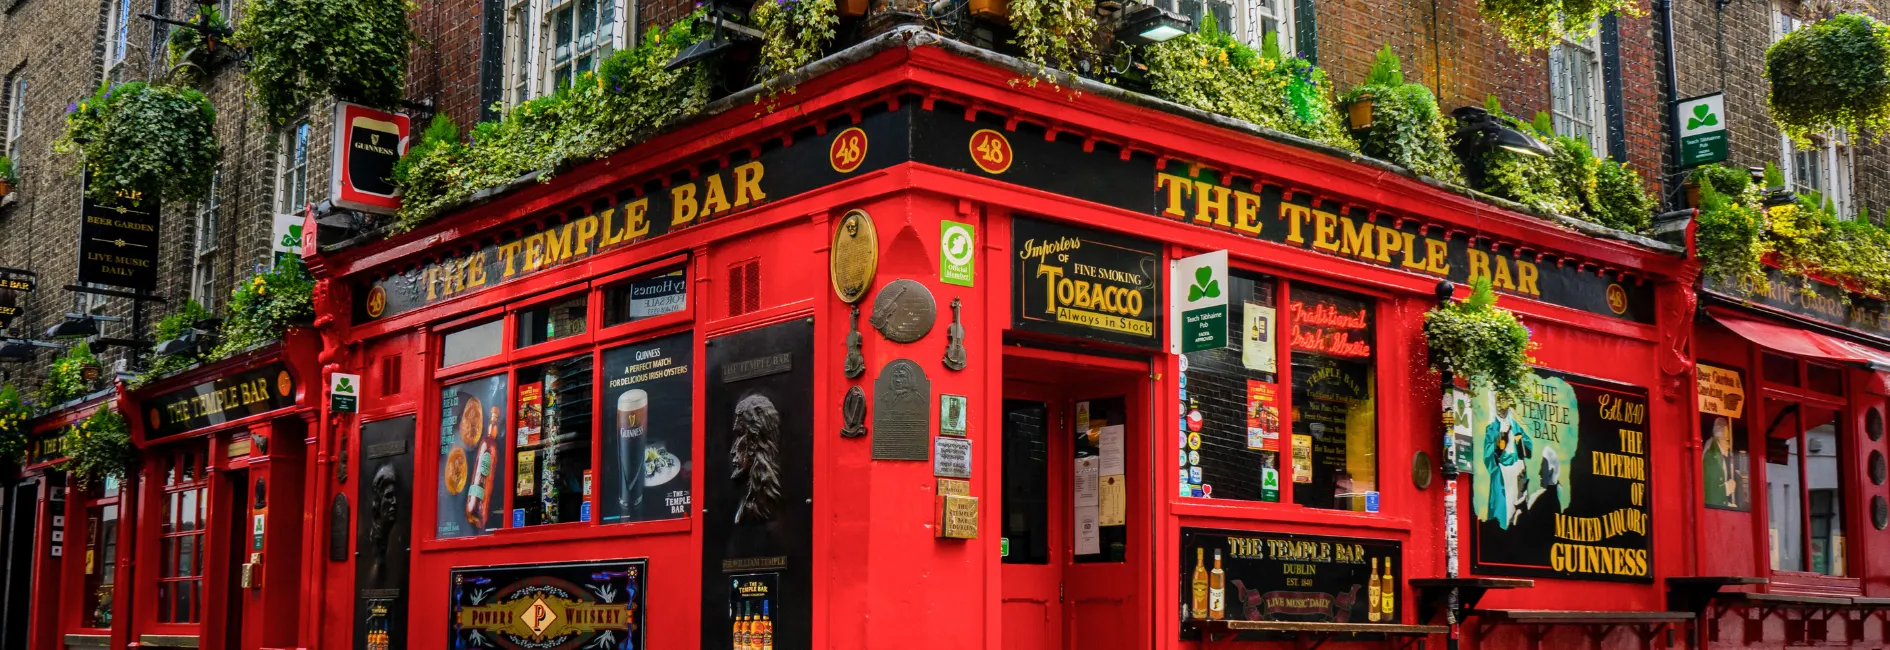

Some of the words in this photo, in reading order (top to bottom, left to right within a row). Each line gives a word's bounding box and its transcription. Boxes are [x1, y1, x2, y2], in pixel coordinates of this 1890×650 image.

[354, 141, 394, 156] GUINNESS
[835, 136, 860, 165] 48
[977, 135, 1003, 163] 48
[87, 215, 112, 226] BEER
[114, 220, 154, 232] GARDEN
[424, 251, 487, 301] THE
[499, 198, 650, 278] TEMPLE
[670, 161, 766, 226] BAR
[1156, 172, 1263, 236] THE
[1280, 201, 1450, 276] TEMPLE
[1466, 247, 1541, 298] BAR
[88, 252, 113, 262] LIVE
[115, 256, 150, 267] MUSIC
[1020, 236, 1081, 263] Importers
[1058, 254, 1069, 263] OF
[101, 265, 134, 276] DAILY
[1074, 263, 1097, 277] FINE
[1098, 268, 1142, 285] SMOKING
[10, 281, 29, 290] BAR
[1036, 263, 1143, 317] TOBACCO
[370, 291, 384, 312] 48
[1060, 308, 1099, 325] Always
[1105, 317, 1116, 327] in
[1120, 319, 1151, 333] Stock
[1290, 301, 1367, 329] Traditional
[1290, 325, 1325, 350] Irish
[625, 366, 630, 374] A
[630, 361, 652, 373] PERFECT
[652, 357, 672, 369] MATCH
[635, 348, 661, 361] GUINNESS
[723, 363, 737, 376] THE
[740, 357, 772, 372] TEMPLE
[773, 354, 791, 366] BAR
[609, 379, 621, 388] FOR
[621, 373, 648, 386] DELICIOUS
[649, 370, 663, 380] IRISH
[663, 365, 688, 377] OYSTERS
[1306, 367, 1341, 387] TEMPLE
[1344, 373, 1361, 395] BAR
[167, 400, 191, 424] THE
[191, 385, 240, 418] TEMPLE
[240, 377, 270, 406] BAR
[1522, 400, 1570, 425] TEMPLE
[1624, 401, 1645, 425] 1840
[620, 427, 643, 438] GUINNESS
[1534, 420, 1560, 443] BAR
[1619, 428, 1644, 455] THE
[44, 439, 57, 455] THE
[1592, 451, 1645, 481] EMPEROR
[665, 496, 691, 506] TEMPLE
[1631, 482, 1645, 506] OF
[1554, 512, 1601, 542] MALTED
[1602, 508, 1647, 539] LIQUORS
[1228, 537, 1263, 559] THE
[1267, 539, 1331, 563] TEMPLE
[1335, 543, 1366, 564] BAR
[1550, 543, 1648, 576] GUINNESS
[1283, 563, 1316, 575] DUBLIN
[1286, 578, 1300, 586] EST.
[1301, 579, 1313, 587] 1840
[1267, 597, 1284, 608] LIVE
[1286, 598, 1308, 608] MUSIC
[1309, 599, 1331, 609] DAILY
[471, 610, 514, 625] POWERS
[533, 604, 547, 629] P
[565, 608, 620, 626] WHISKEY
